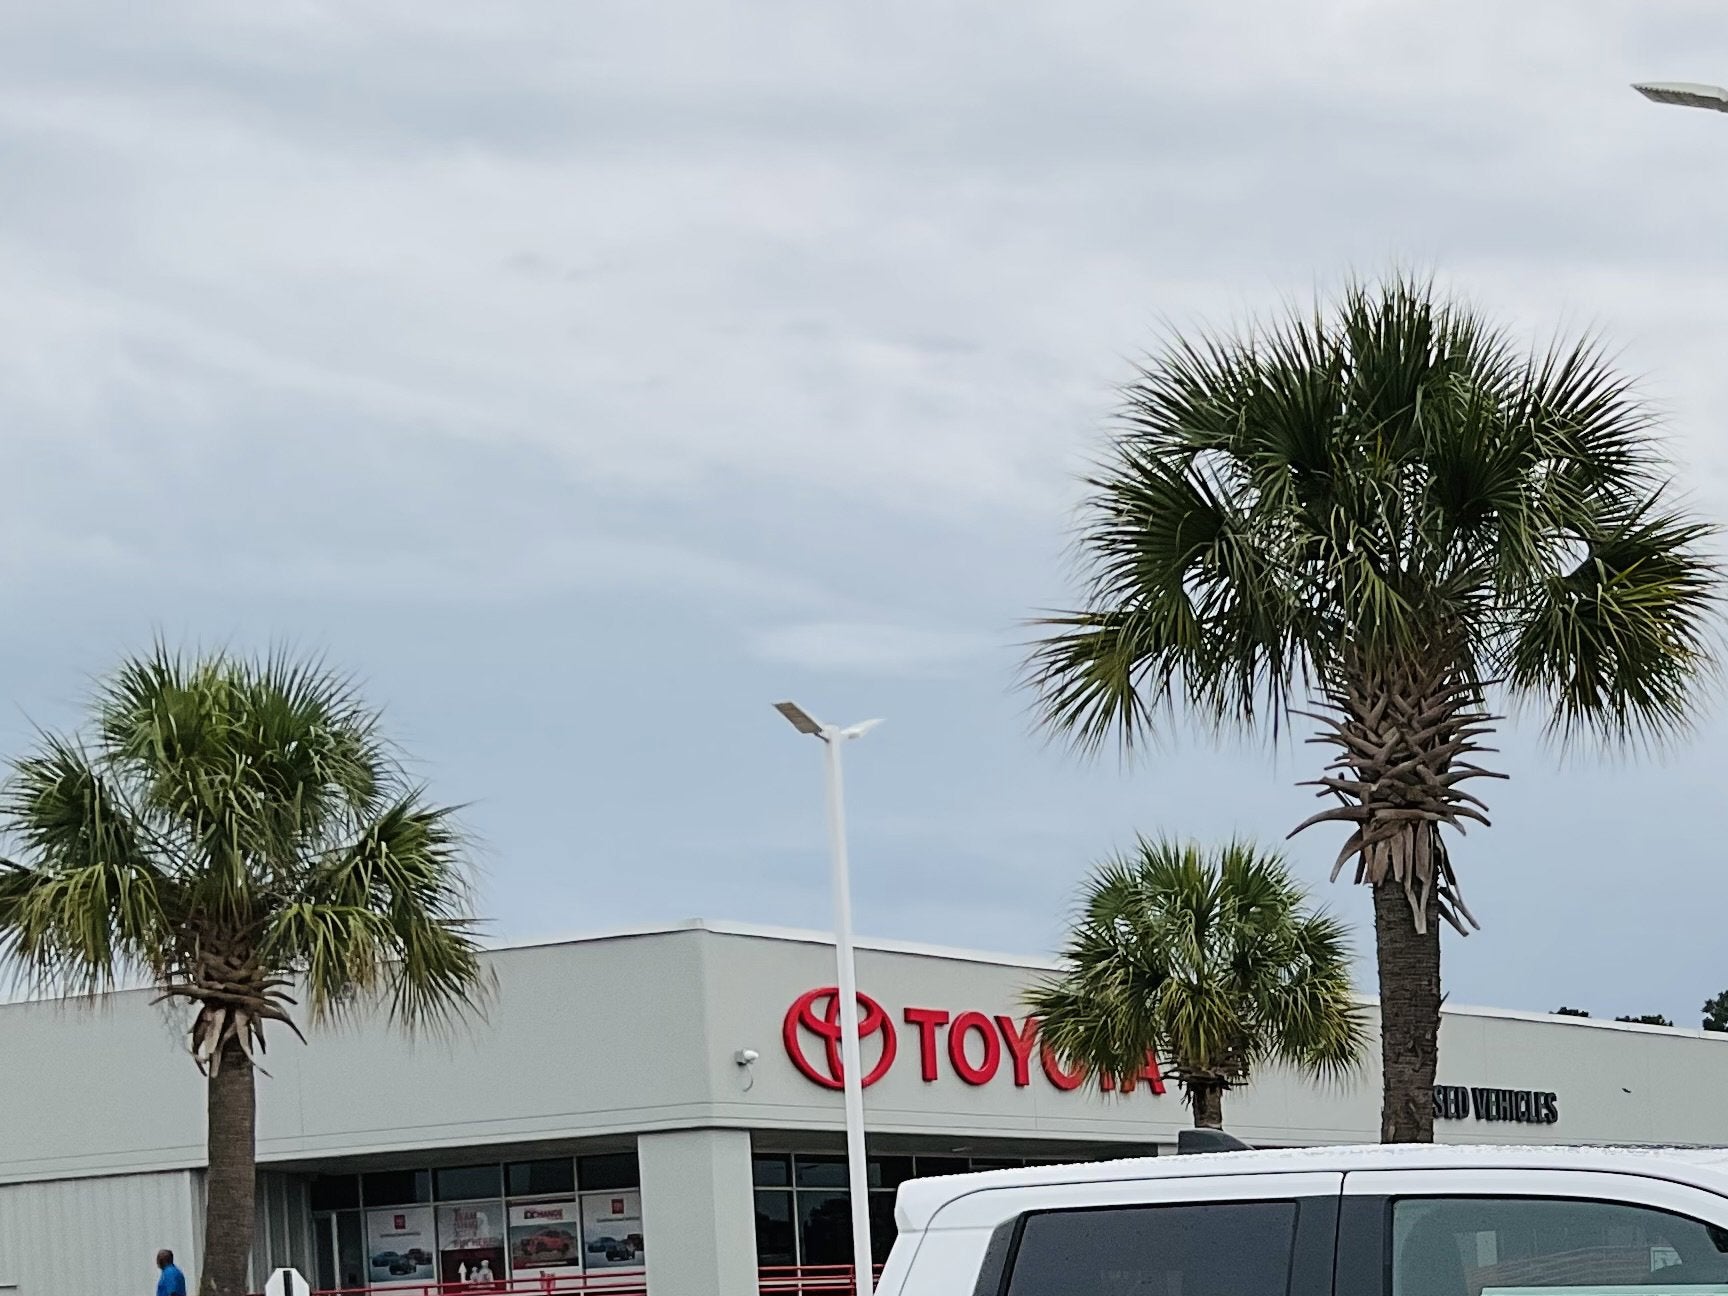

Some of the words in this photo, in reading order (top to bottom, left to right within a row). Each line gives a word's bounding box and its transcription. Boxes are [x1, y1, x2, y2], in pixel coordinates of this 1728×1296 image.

[904, 1007, 1166, 1095] TOYOA
[1433, 1085, 1470, 1120] SED
[1471, 1087, 1559, 1124] VEHICLES
